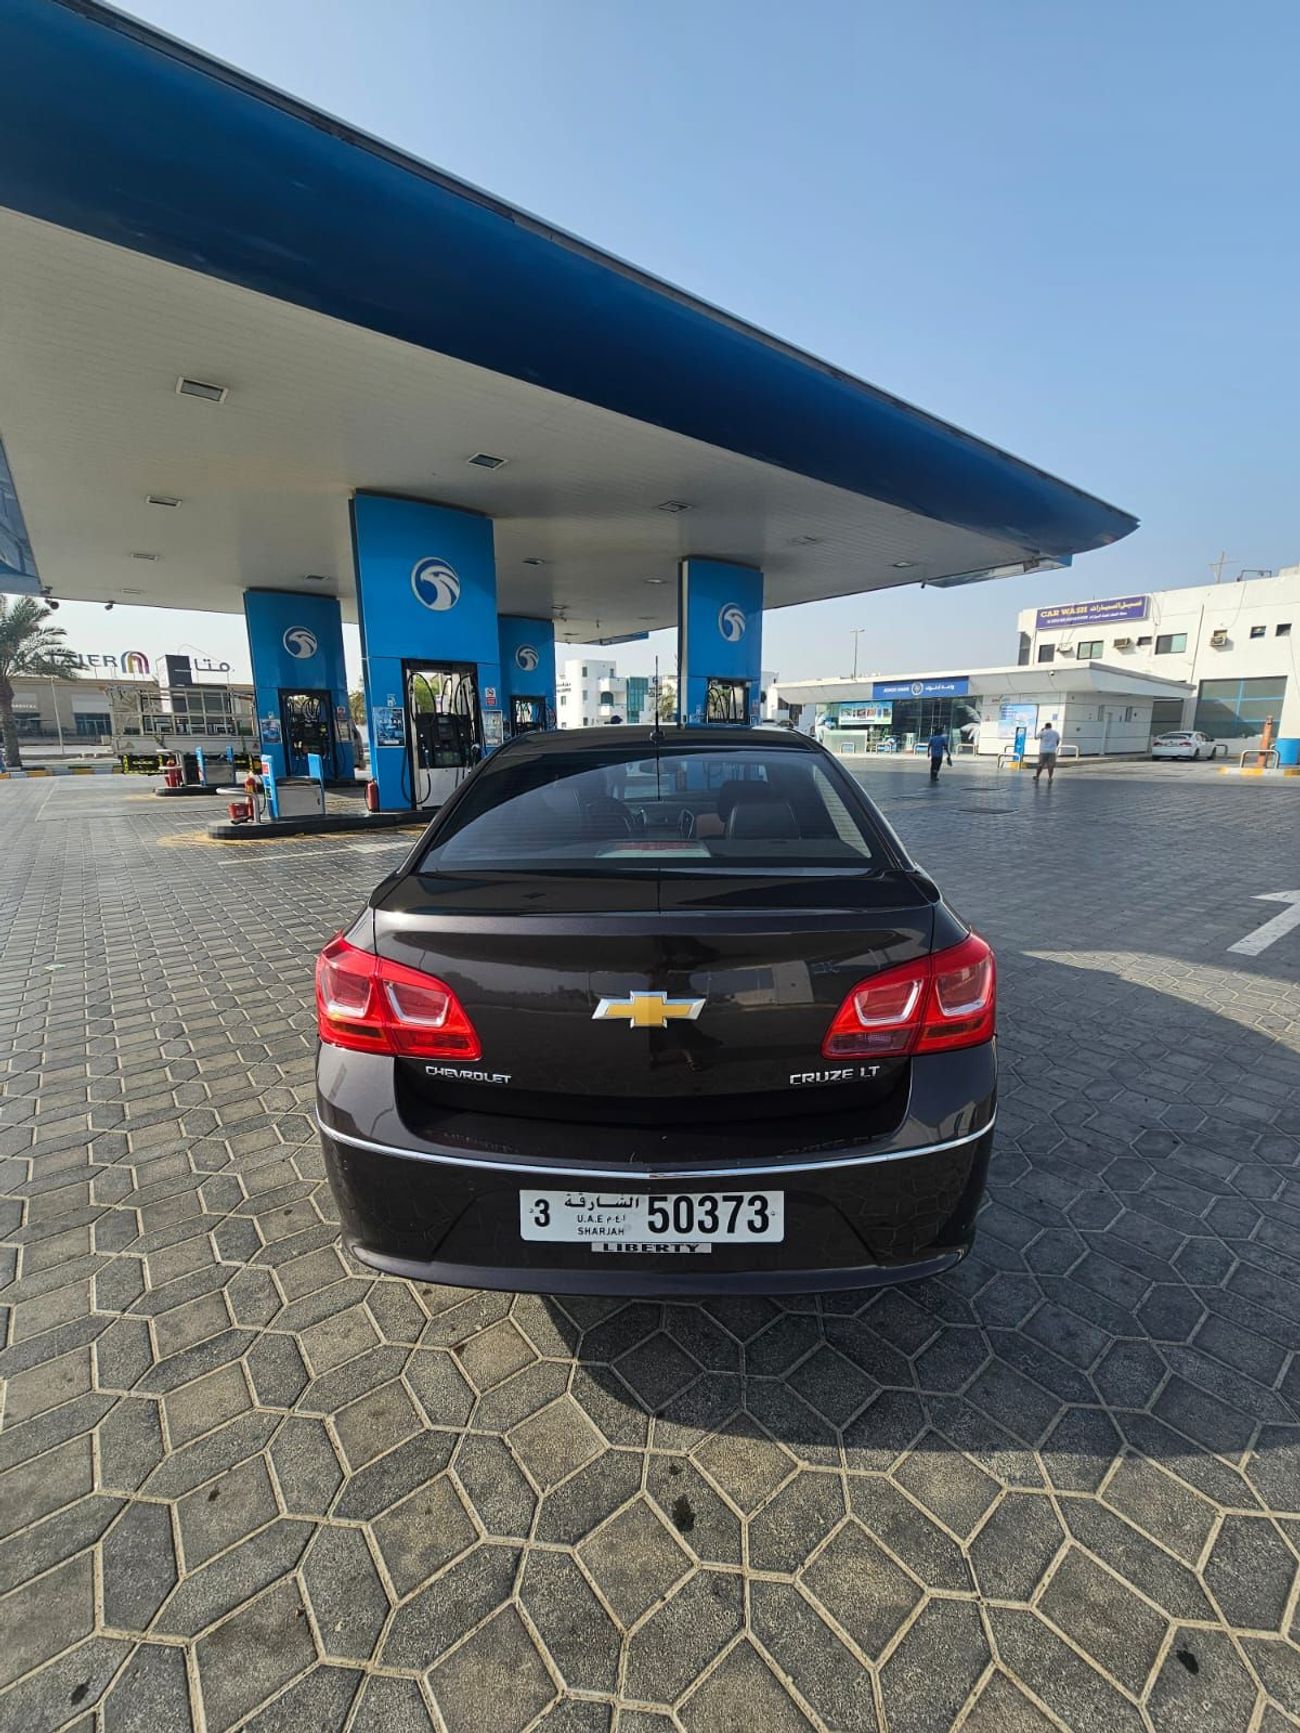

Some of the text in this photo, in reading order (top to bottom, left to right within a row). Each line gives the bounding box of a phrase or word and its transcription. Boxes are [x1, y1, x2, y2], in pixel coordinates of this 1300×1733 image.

[1040, 609, 1060, 618] CAR
[1061, 606, 1088, 616] WASH
[425, 1065, 512, 1084] CHEVROLET
[789, 1065, 880, 1085] CRUZE LT
[564, 1193, 640, 1211] الشارقة
[534, 1199, 551, 1228] 3
[577, 1214, 604, 1223] U.A.E
[647, 1194, 770, 1235] 50373
[577, 1226, 625, 1236] SHARJAH
[602, 1243, 700, 1253] LIBERTY
